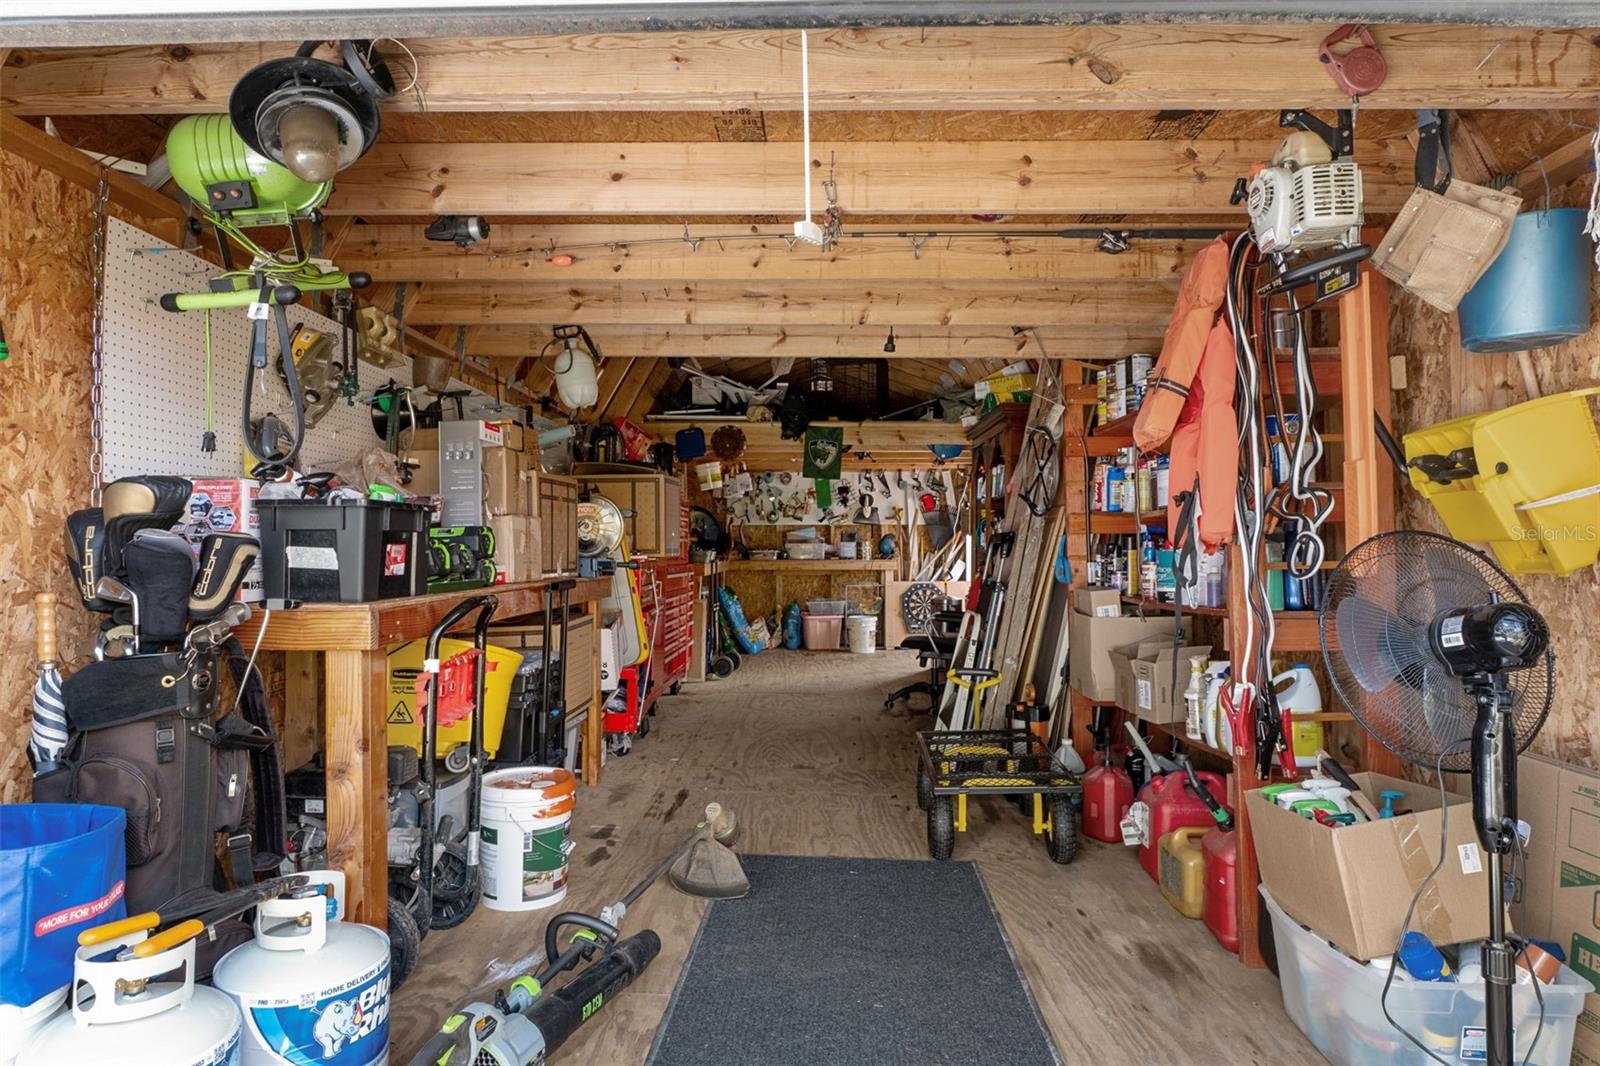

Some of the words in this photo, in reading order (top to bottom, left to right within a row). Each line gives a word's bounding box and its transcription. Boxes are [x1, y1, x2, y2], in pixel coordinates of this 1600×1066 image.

[83, 525, 95, 600] cobra
[199, 537, 223, 596] cobra
[69, 907, 90, 921] FOR
[320, 984, 345, 997] HOME
[346, 968, 377, 989] DELIVERY
